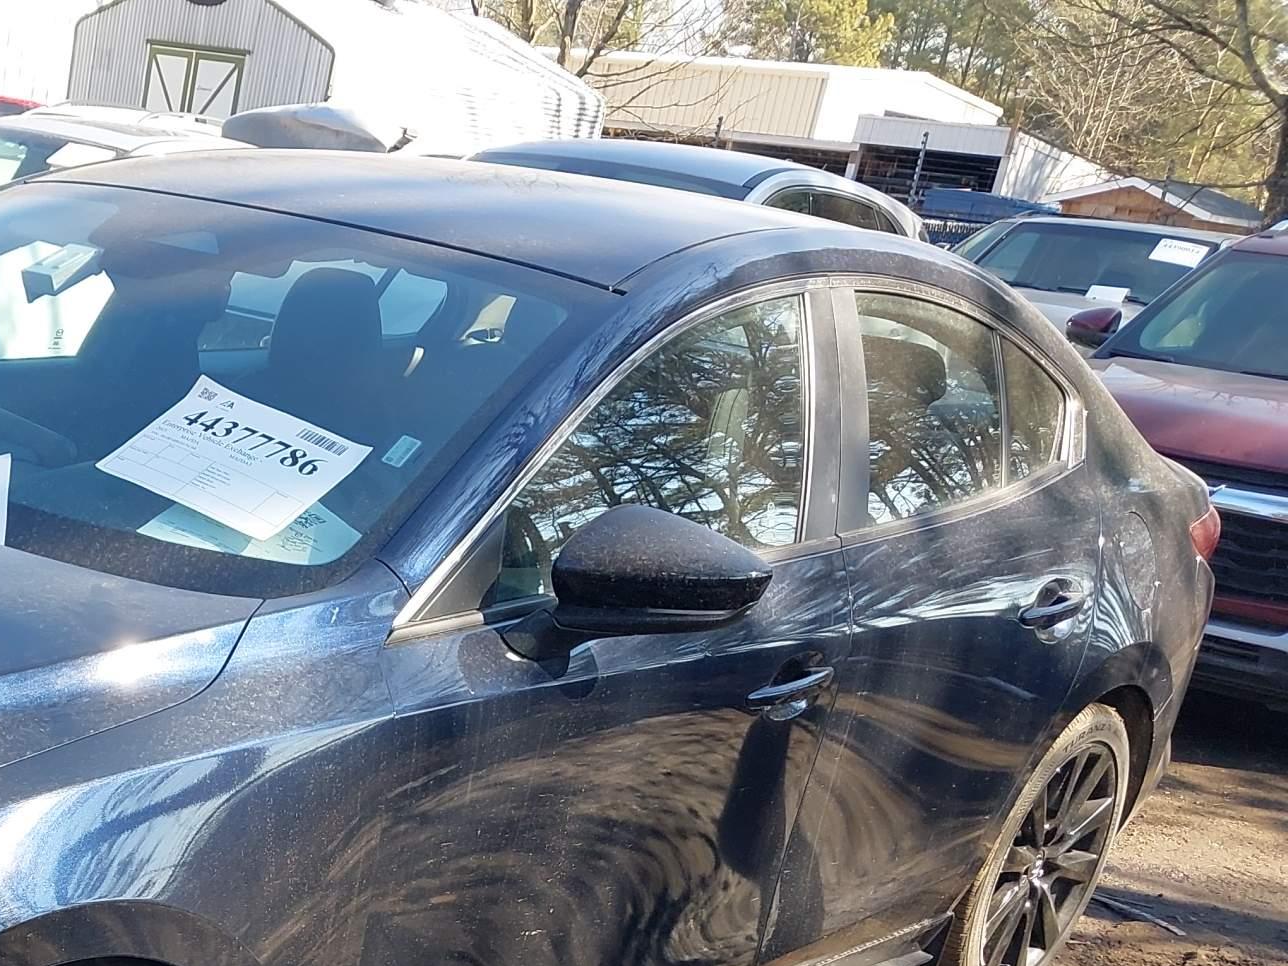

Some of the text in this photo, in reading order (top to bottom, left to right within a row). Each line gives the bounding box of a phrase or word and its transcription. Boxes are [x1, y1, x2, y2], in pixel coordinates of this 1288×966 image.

[162, 419, 198, 437] Enterprise
[198, 431, 225, 448] Vehicle
[224, 442, 259, 462] Exchange
[182, 410, 328, 476] 44377786
